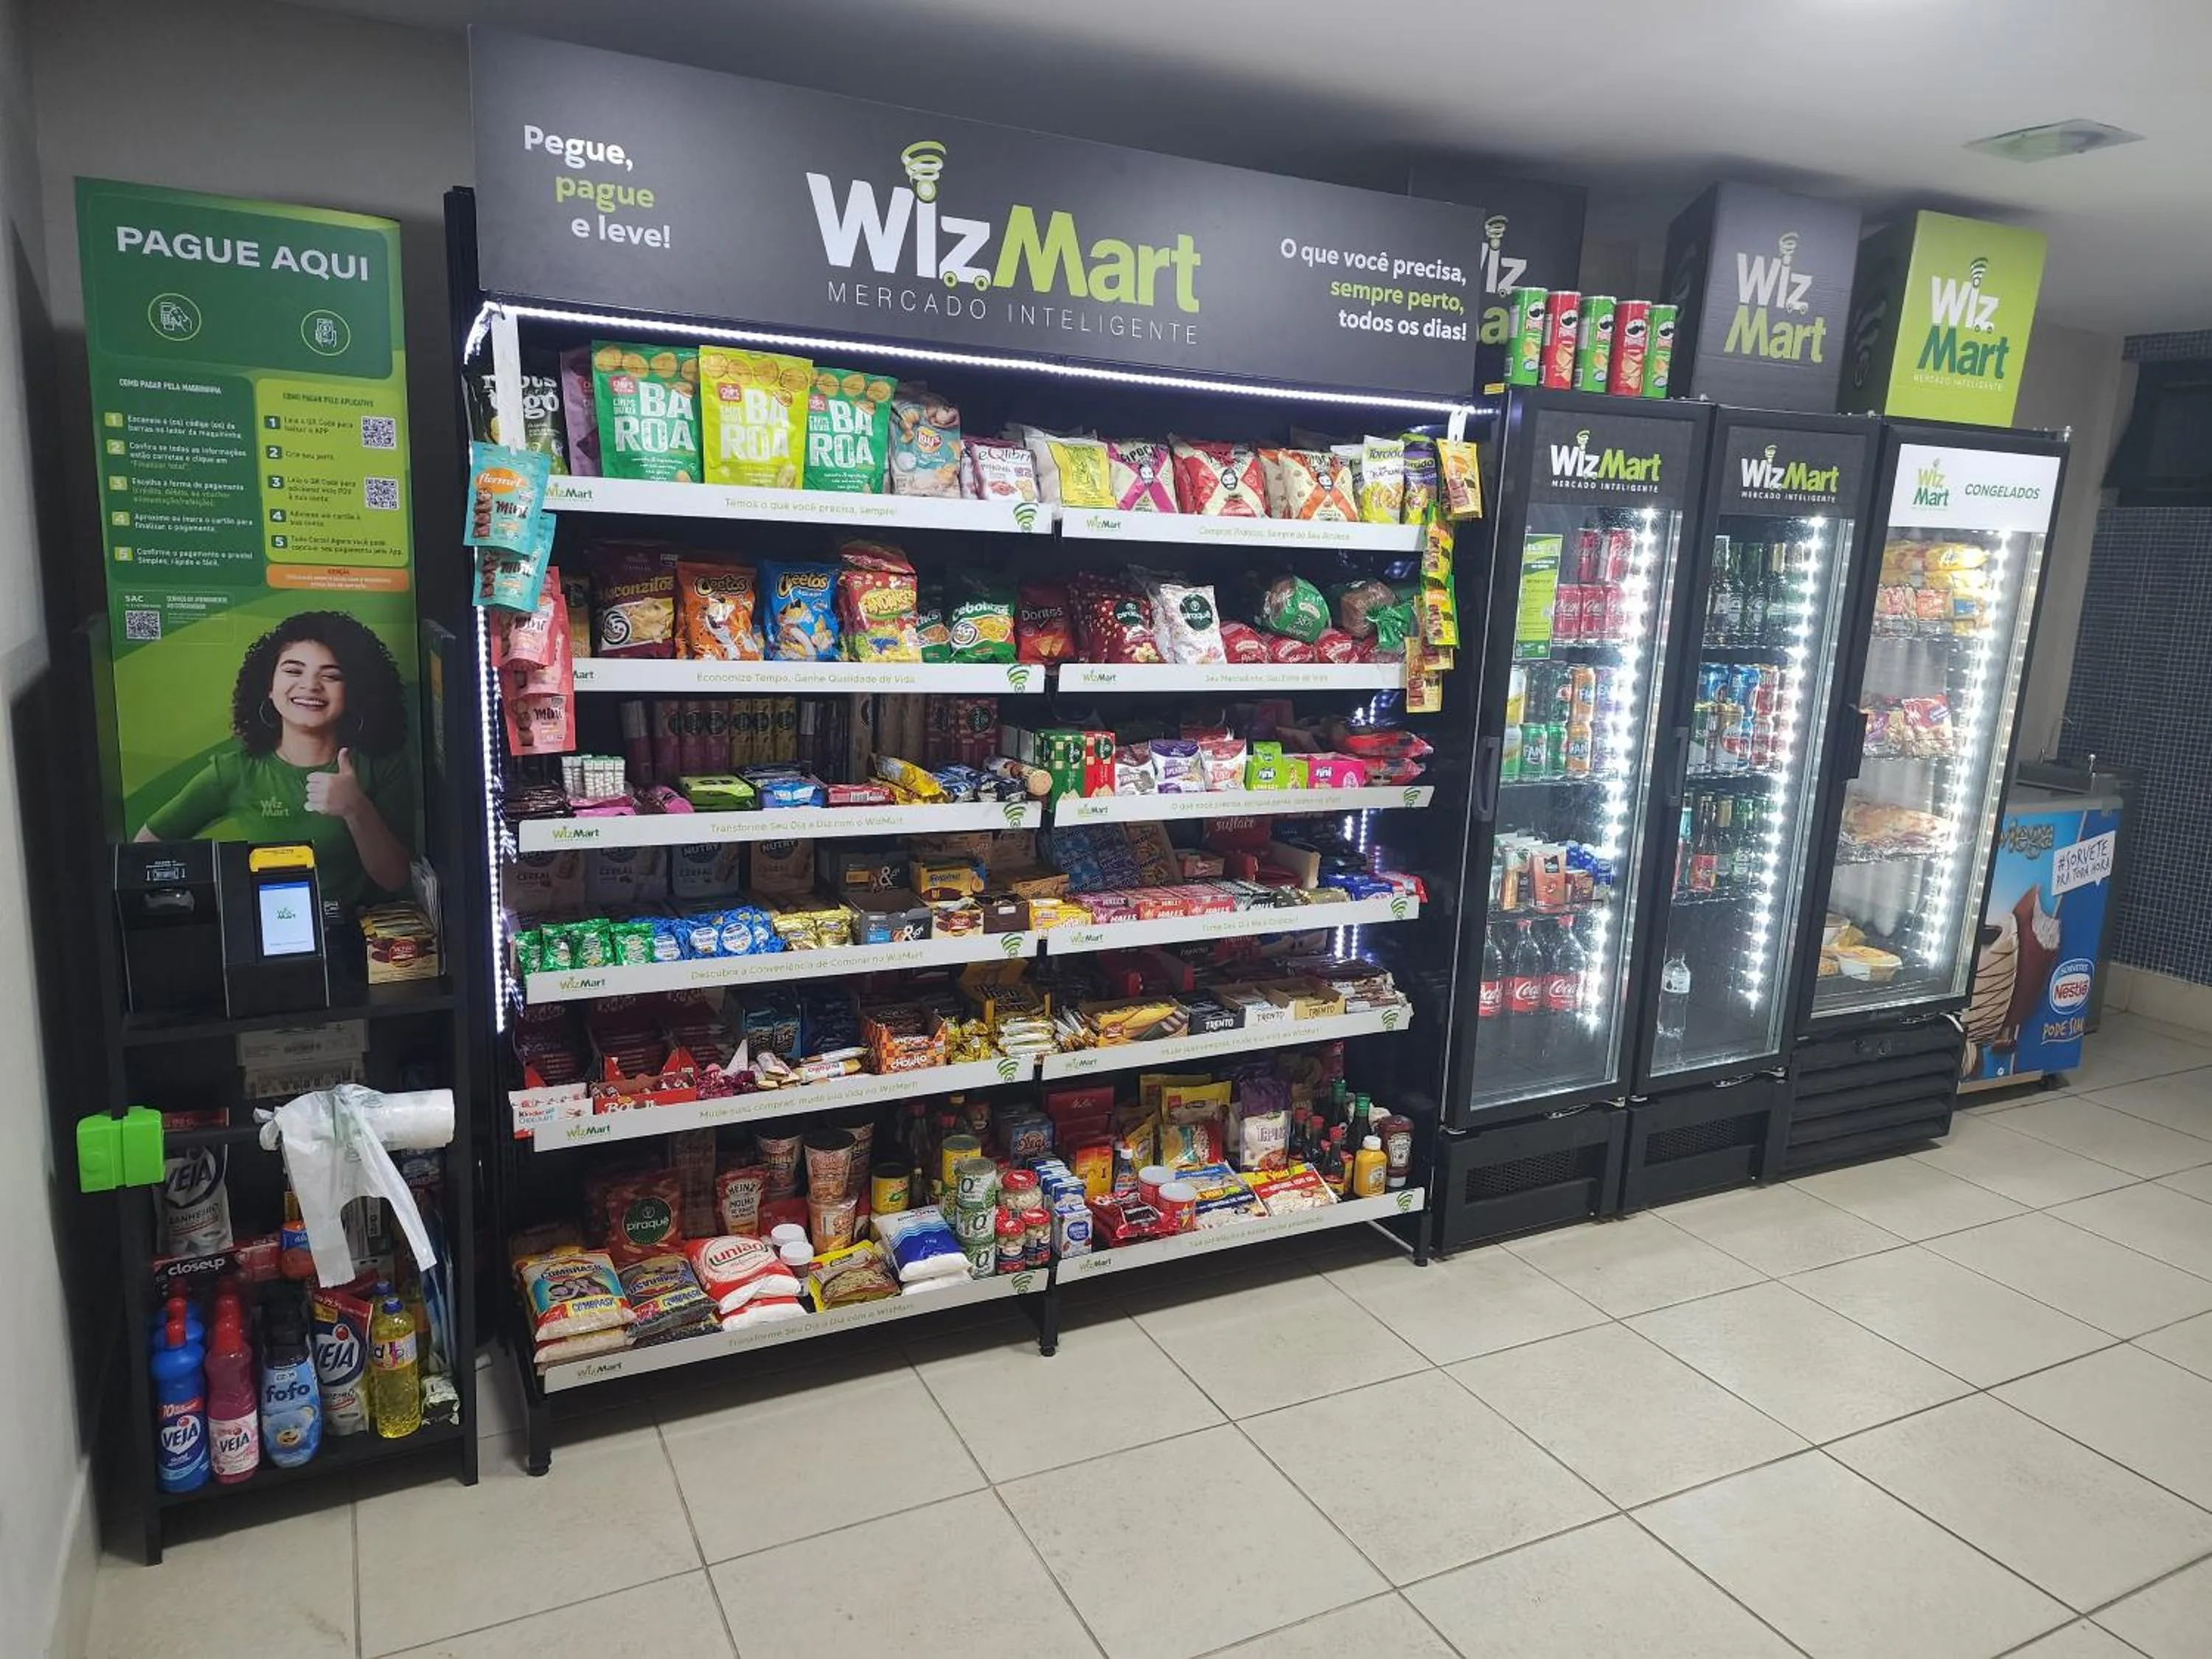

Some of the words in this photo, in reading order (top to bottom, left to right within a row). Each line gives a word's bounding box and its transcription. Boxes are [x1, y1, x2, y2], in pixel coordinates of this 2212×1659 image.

[524, 125, 633, 171] Pegue,
[554, 175, 655, 213] pague
[571, 218, 590, 238] e
[599, 214, 671, 248] leve!
[806, 172, 1200, 313] WizMart
[116, 226, 260, 268] PAGUE
[271, 246, 369, 282] AQUI
[1280, 237, 1298, 259] O
[1301, 244, 1339, 268] que
[1343, 251, 1388, 274] você
[1393, 257, 1467, 286] precisa,
[1481, 242, 1527, 296] iz
[1329, 279, 1404, 307] sempre
[1407, 289, 1464, 316] perto,
[1736, 252, 1812, 315] Wiz
[827, 280, 988, 320] MERCADO
[1007, 305, 1198, 345] INTELIGENTE
[1930, 276, 1999, 333] Wiz
[1338, 310, 1393, 333] todos
[1398, 316, 1420, 335] os
[1423, 317, 1467, 341] dias!
[1723, 305, 1827, 364] Mart
[1917, 324, 2009, 380] Mart
[638, 381, 695, 421] BA
[268, 417, 276, 428] 1
[828, 398, 874, 437] BA
[614, 415, 697, 453] ROA
[720, 422, 790, 462] ROA
[809, 432, 876, 468] ROA
[269, 447, 279, 459] 2
[1550, 444, 1662, 482] WizMart
[272, 476, 281, 487] 3
[1551, 479, 1597, 490] MERCADO
[1599, 481, 1659, 494] INTELIGENTE
[1740, 458, 1840, 493] WizMart
[1964, 482, 2041, 500] CONGELADOS
[725, 497, 759, 509] Temos
[770, 503, 790, 512] que
[1740, 490, 1781, 501] MERCADO
[1784, 492, 1836, 504] INTELIGENTE
[1912, 487, 1950, 507] Mart
[273, 510, 283, 521] 4
[274, 537, 285, 548] 5
[125, 594, 145, 602] SAC
[696, 672, 752, 683] Economize
[754, 672, 791, 684] Tempo,
[793, 672, 827, 683] Ganhe
[552, 827, 600, 839] WizMart
[2058, 838, 2109, 872] #SORVETE
[560, 978, 605, 990] WizMart
[2053, 979, 2089, 1001] Nestlé
[566, 1124, 611, 1139] WizMart
[167, 1256, 225, 1276] closeup
[265, 1381, 310, 1403] fofo
[163, 1423, 198, 1450] VEJA
[219, 1432, 250, 1453] VEJA
